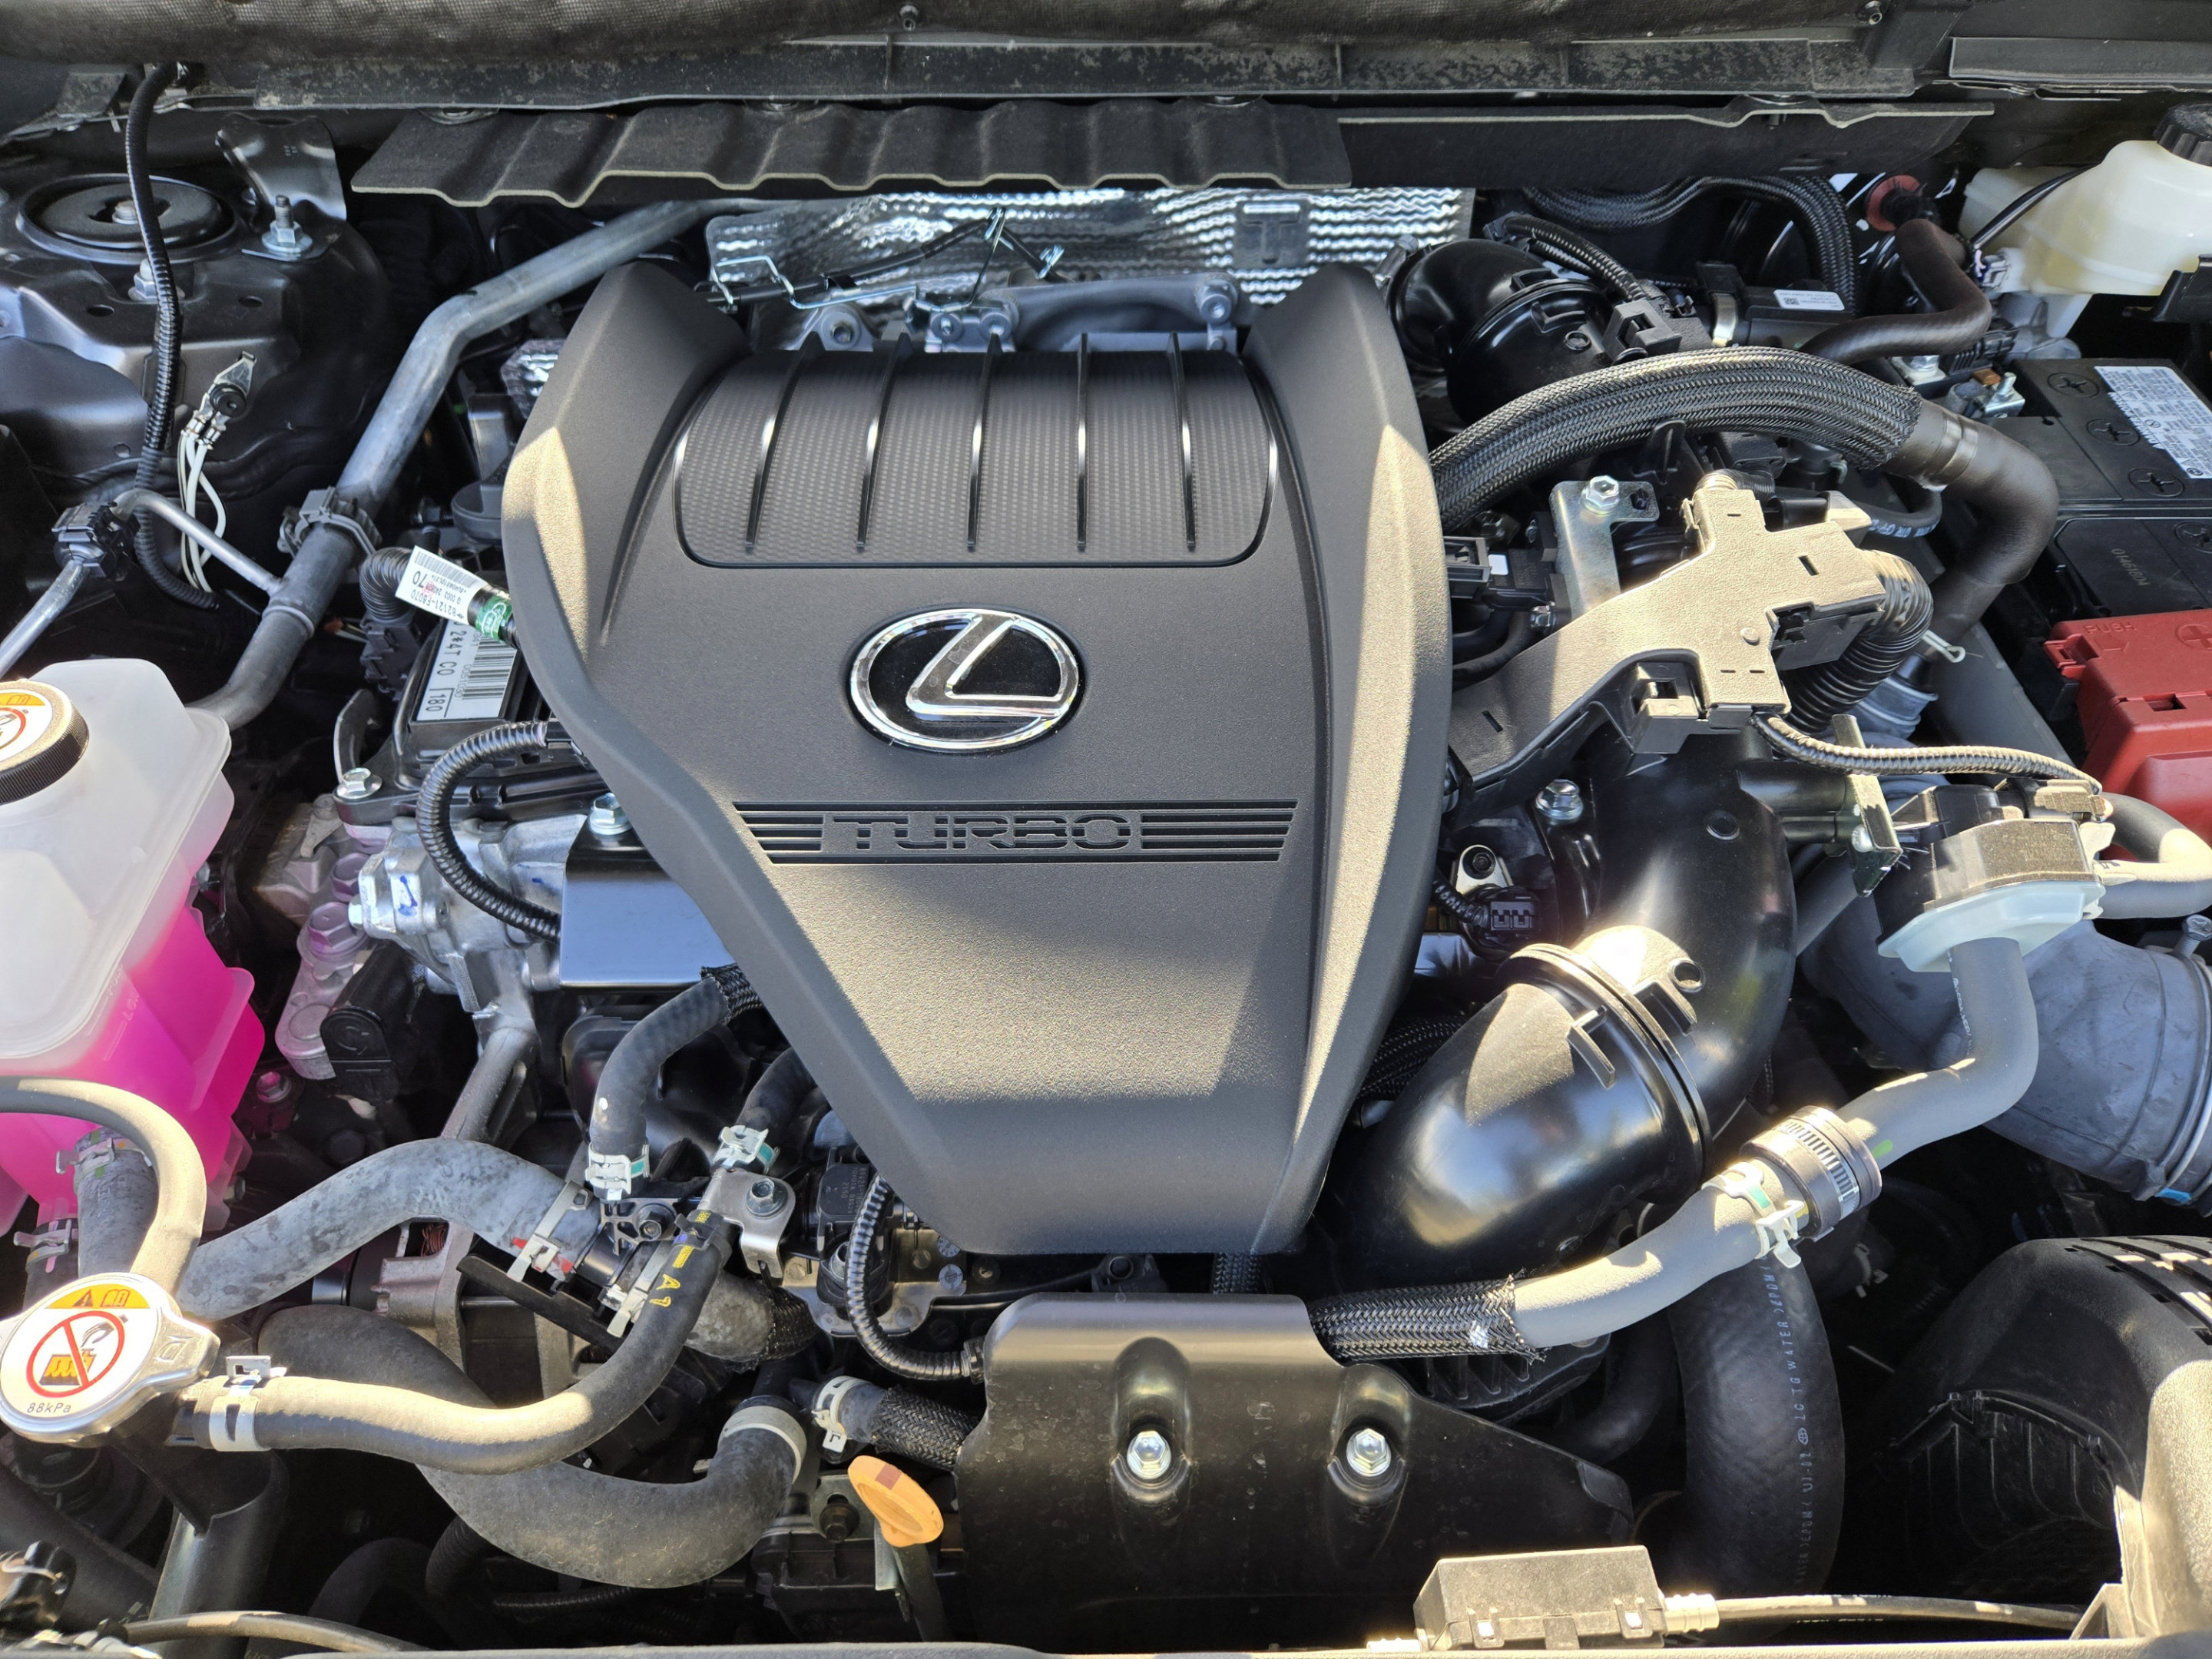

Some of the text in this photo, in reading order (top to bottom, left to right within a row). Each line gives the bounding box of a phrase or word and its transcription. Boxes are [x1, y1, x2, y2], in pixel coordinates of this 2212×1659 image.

[412, 571, 427, 589] 70
[2084, 621, 2137, 634] PUSH
[426, 694, 446, 712] 180
[833, 813, 1131, 850] TURBO
[1777, 1320, 1797, 1370] WATER
[27, 1402, 71, 1413] 88kPa
